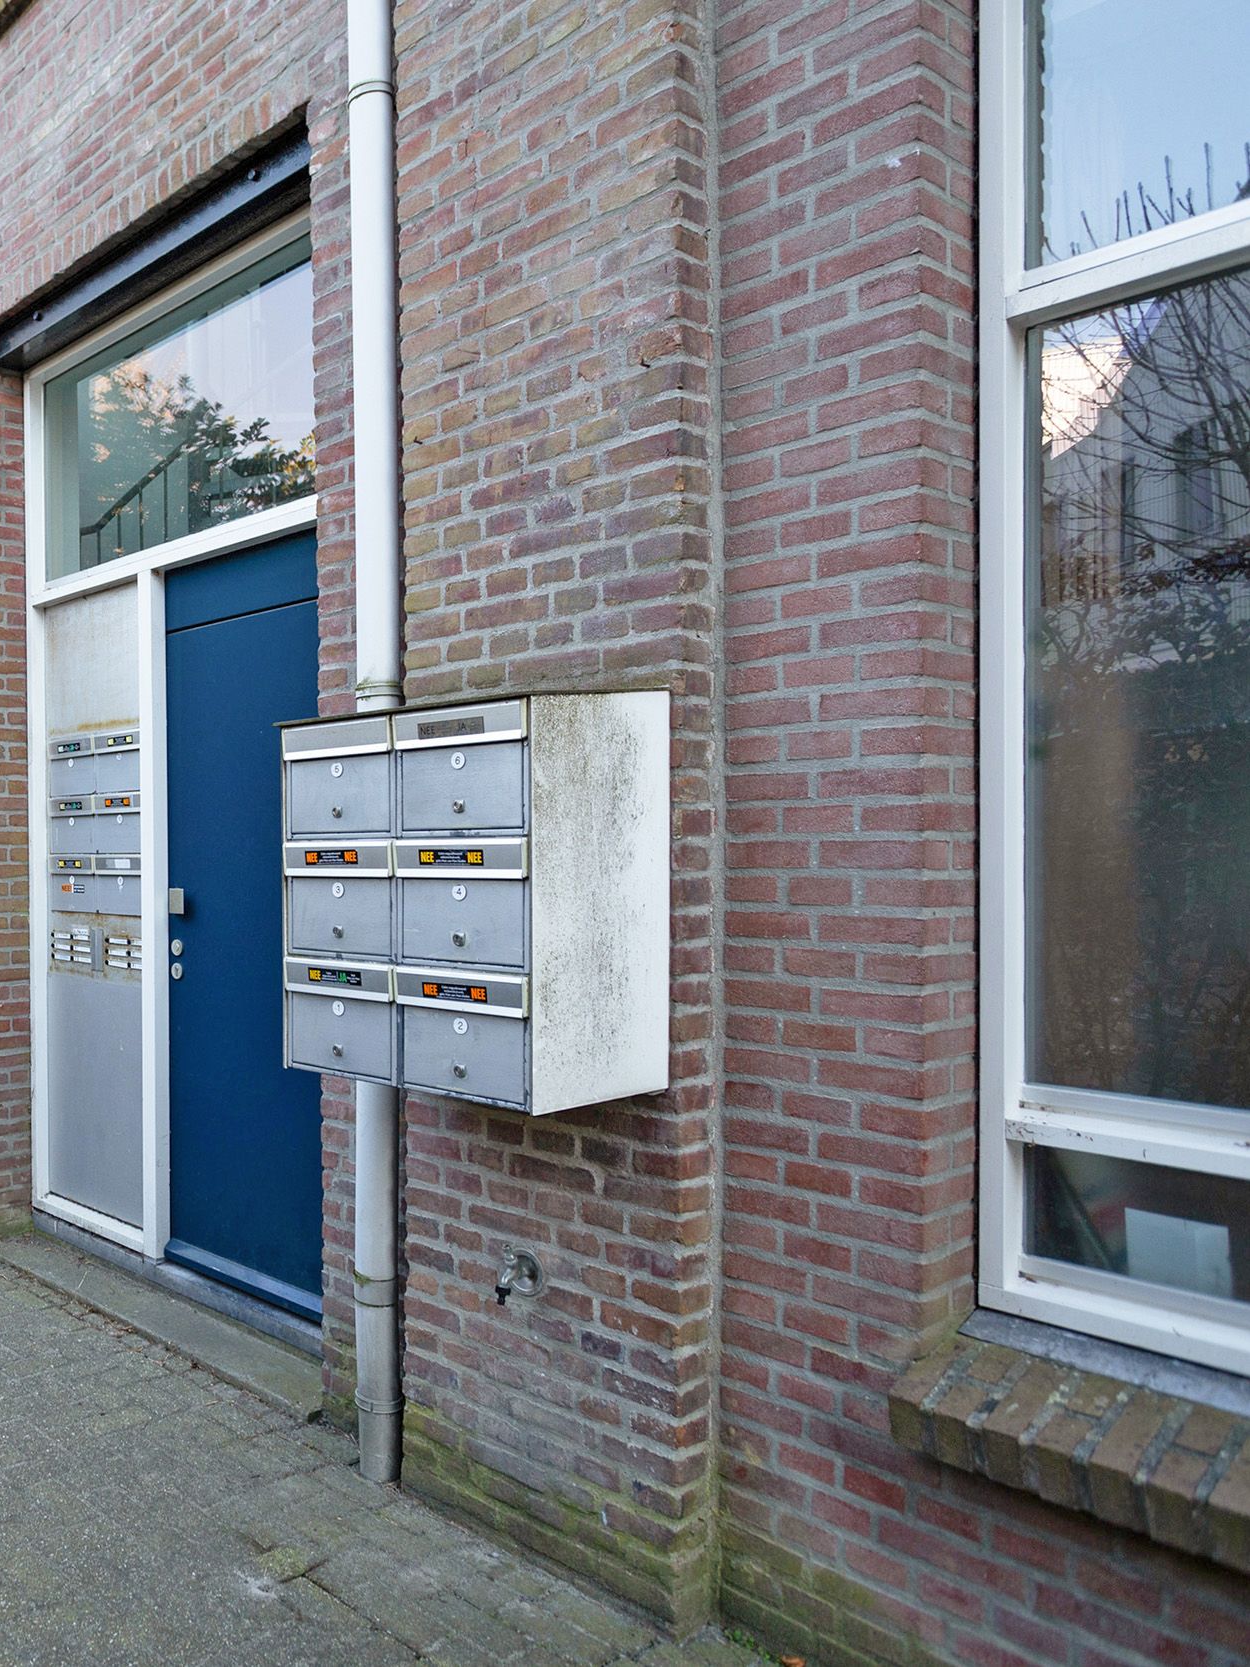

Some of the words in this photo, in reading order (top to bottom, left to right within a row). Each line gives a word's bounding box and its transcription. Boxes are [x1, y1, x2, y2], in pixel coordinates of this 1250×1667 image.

[420, 725, 435, 736] NEE
[306, 852, 318, 863] NEE
[344, 851, 357, 862] NEE
[420, 851, 435, 863] NEE
[467, 851, 482, 864] NEE
[309, 969, 321, 980] NEE
[338, 971, 348, 983] JA
[423, 983, 438, 996] NEE
[470, 987, 486, 1000] NEE
